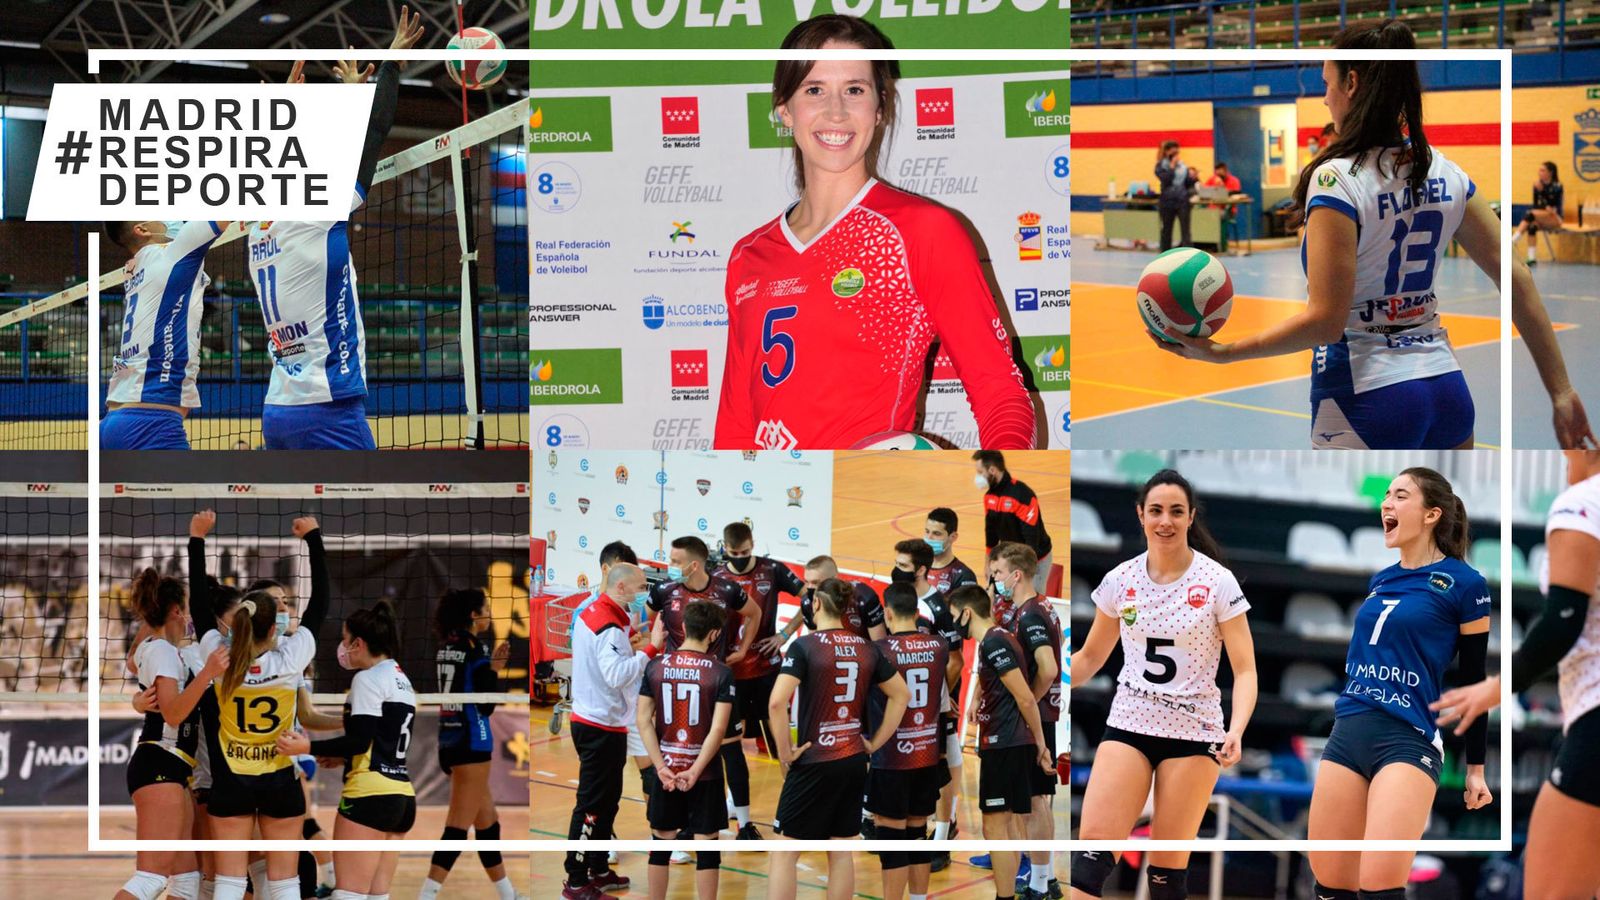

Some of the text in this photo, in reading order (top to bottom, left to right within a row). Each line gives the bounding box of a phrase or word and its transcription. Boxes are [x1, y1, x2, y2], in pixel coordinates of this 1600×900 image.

[900, 156, 949, 177] GEFF
[645, 165, 694, 185] GEFF
[538, 173, 554, 195] 8
[643, 185, 724, 204] VOLLEYBALL
[1046, 225, 1068, 234] Real
[535, 239, 611, 250] Real Federación
[1384, 210, 1444, 295] 13
[536, 253, 580, 264] Española
[648, 249, 721, 259] FUNDAL
[1047, 250, 1059, 259] de
[536, 265, 588, 274] de Voleibol
[257, 264, 282, 326] 11
[529, 303, 617, 312] PROFESSIONAL
[666, 304, 729, 316] ALCOBEND
[529, 314, 581, 322] ANSWER
[761, 304, 799, 389] 5
[529, 384, 601, 396] IBERDROLA
[653, 417, 703, 438] GEFF
[546, 425, 562, 447] 8
[1368, 599, 1401, 646] 7
[833, 633, 866, 644] bizum
[905, 639, 941, 650] bizum
[834, 645, 857, 657] ALEX
[896, 651, 935, 665] MARCOS
[675, 654, 713, 668] bizum
[1142, 636, 1178, 685] 5
[663, 667, 701, 680] ROMERA
[1355, 663, 1420, 687] MADRID
[833, 661, 859, 703] 3
[905, 667, 930, 709] 6
[661, 682, 701, 726] 17
[232, 696, 282, 734] 13
